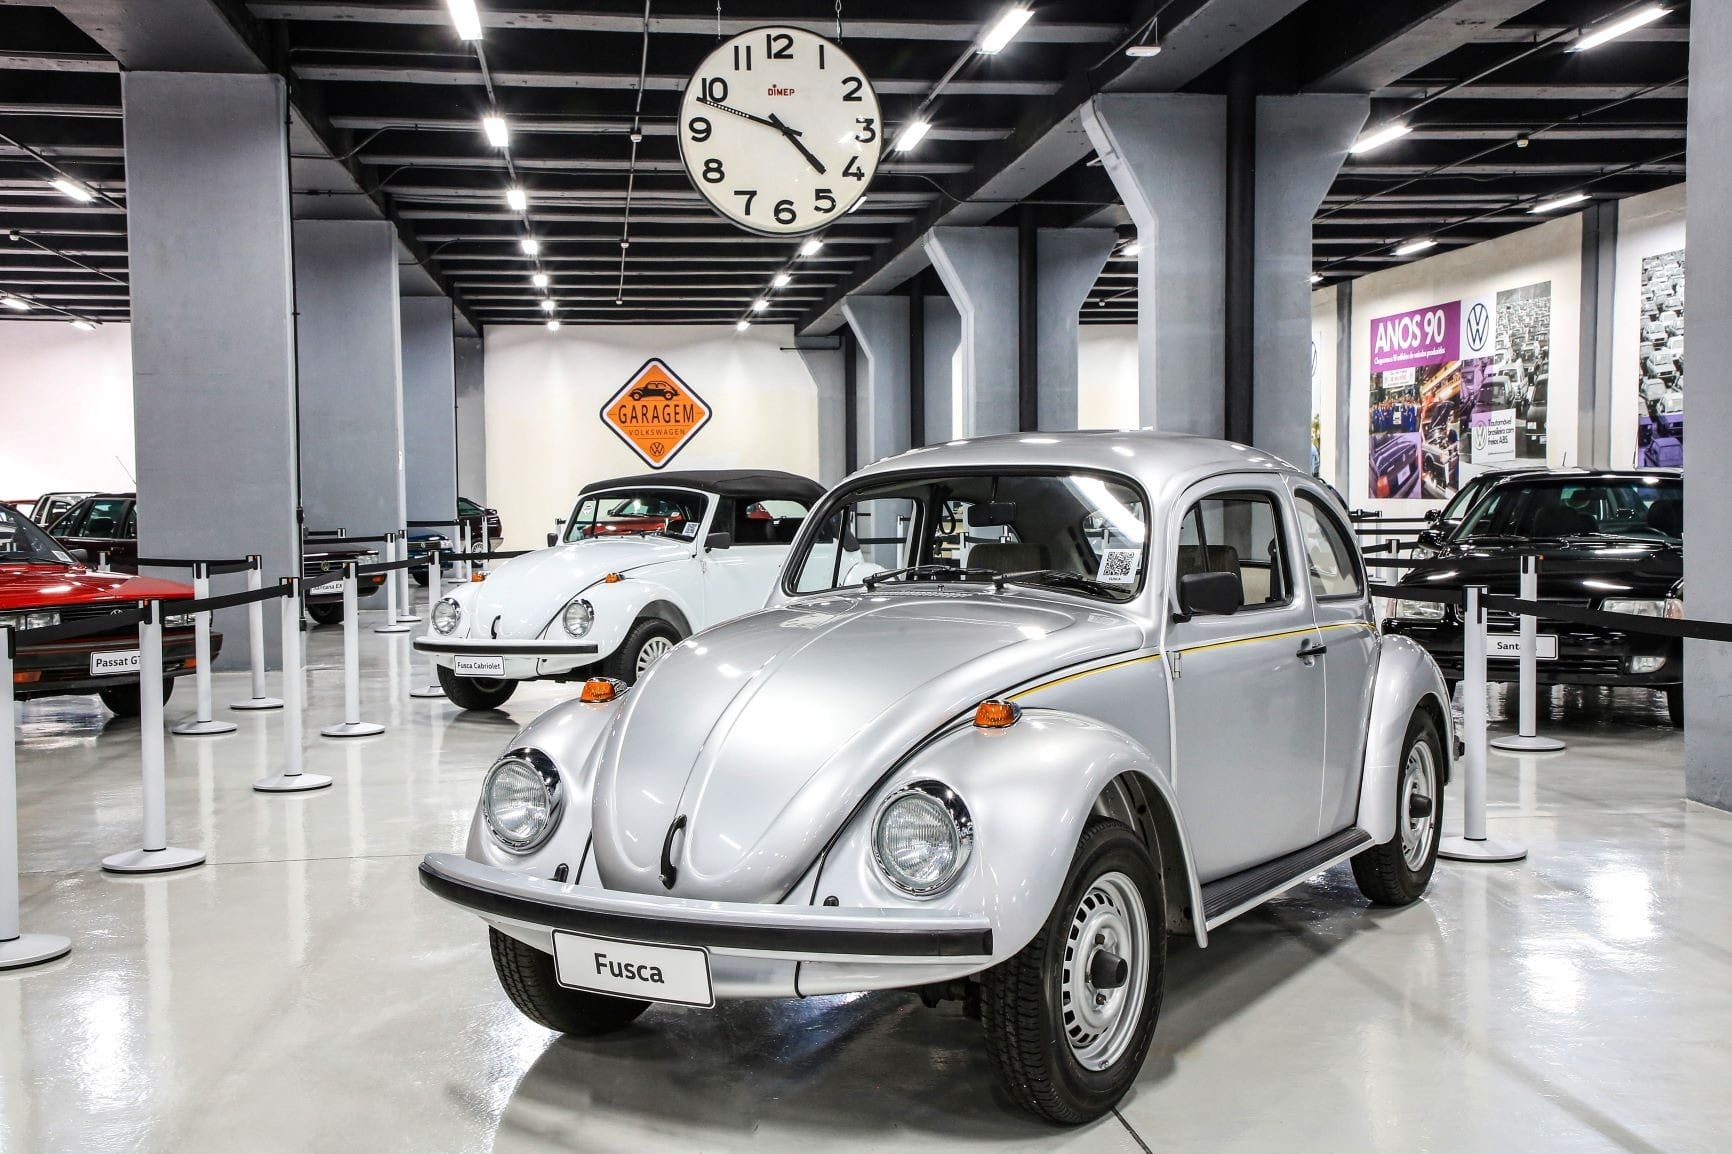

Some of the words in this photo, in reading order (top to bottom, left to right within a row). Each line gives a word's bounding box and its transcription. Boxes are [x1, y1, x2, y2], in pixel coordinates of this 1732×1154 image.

[734, 45, 752, 71] 11
[766, 33, 794, 59] 12
[819, 44, 825, 70] 1
[701, 77, 728, 103] 10
[767, 84, 795, 97] DIMEP
[841, 76, 863, 102] 2
[688, 117, 712, 142] 9
[855, 117, 876, 143] 3
[702, 158, 725, 183] 8
[842, 156, 865, 181] 4
[734, 190, 757, 216] 7
[774, 199, 797, 225] 6
[814, 188, 837, 214] 5
[1374, 313, 1422, 354] ANOS
[1423, 309, 1446, 345] 90
[618, 404, 694, 424] GARAGEM
[629, 428, 685, 436] VOLKSWAGEN
[96, 658, 128, 668] Passat
[473, 662, 501, 670] Cabriolet
[594, 952, 665, 984] Fusca
